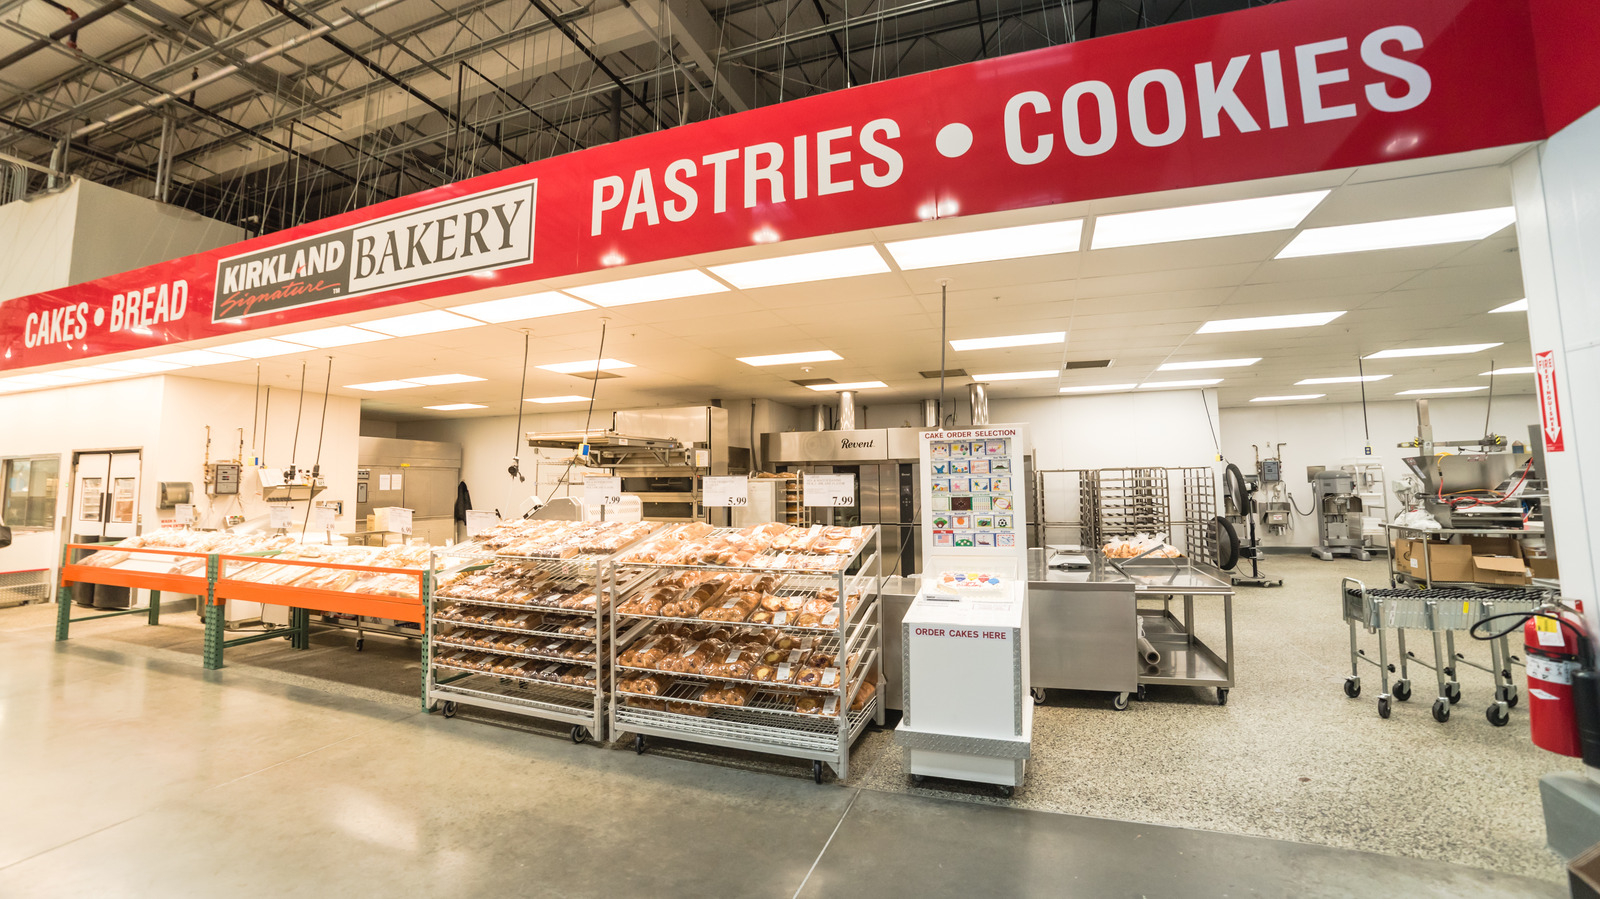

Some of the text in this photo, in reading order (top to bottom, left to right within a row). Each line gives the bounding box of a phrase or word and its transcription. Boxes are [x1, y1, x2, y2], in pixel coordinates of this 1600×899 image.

[591, 25, 1432, 237] PASTRIES COOKIES
[353, 199, 525, 280] BAKERY
[223, 240, 346, 294] KIRKLAND
[219, 279, 342, 317] Signature
[24, 279, 189, 349] CAKES BREAD
[946, 431, 972, 439] ORDER
[975, 429, 1016, 438] SELECTION
[841, 438, 874, 449] Revent
[604, 496, 621, 504] 7.99
[727, 496, 747, 506] 5.99
[832, 496, 853, 506] 7.99
[915, 627, 1007, 640] ORDER CAKES HERE
